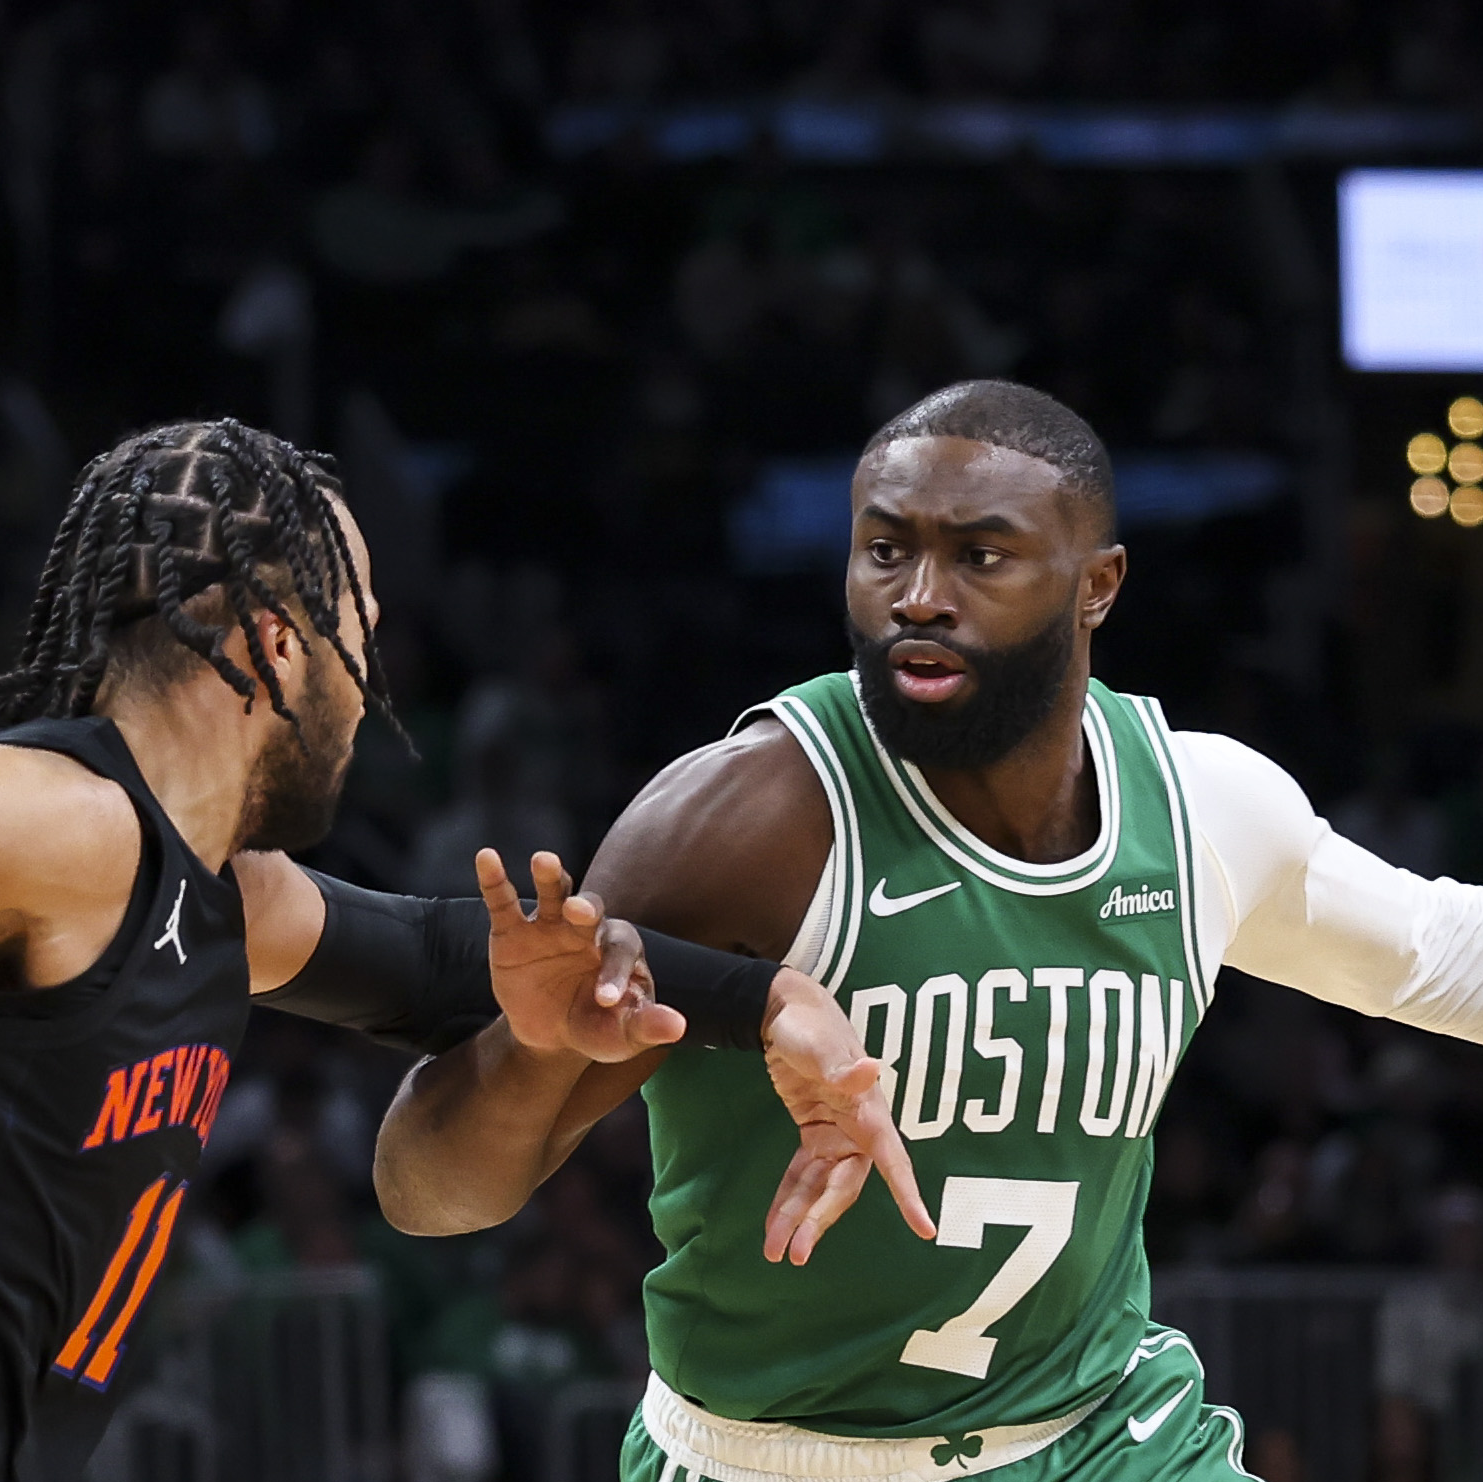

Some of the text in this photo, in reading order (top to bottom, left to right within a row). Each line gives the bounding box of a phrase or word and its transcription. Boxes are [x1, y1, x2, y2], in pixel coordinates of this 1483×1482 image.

[1099, 884, 1175, 919] Amica
[79, 1043, 208, 1153] NEW
[850, 967, 1184, 1141] BOSTON
[52, 1172, 189, 1392] 11
[900, 1176, 1081, 1379] 7
